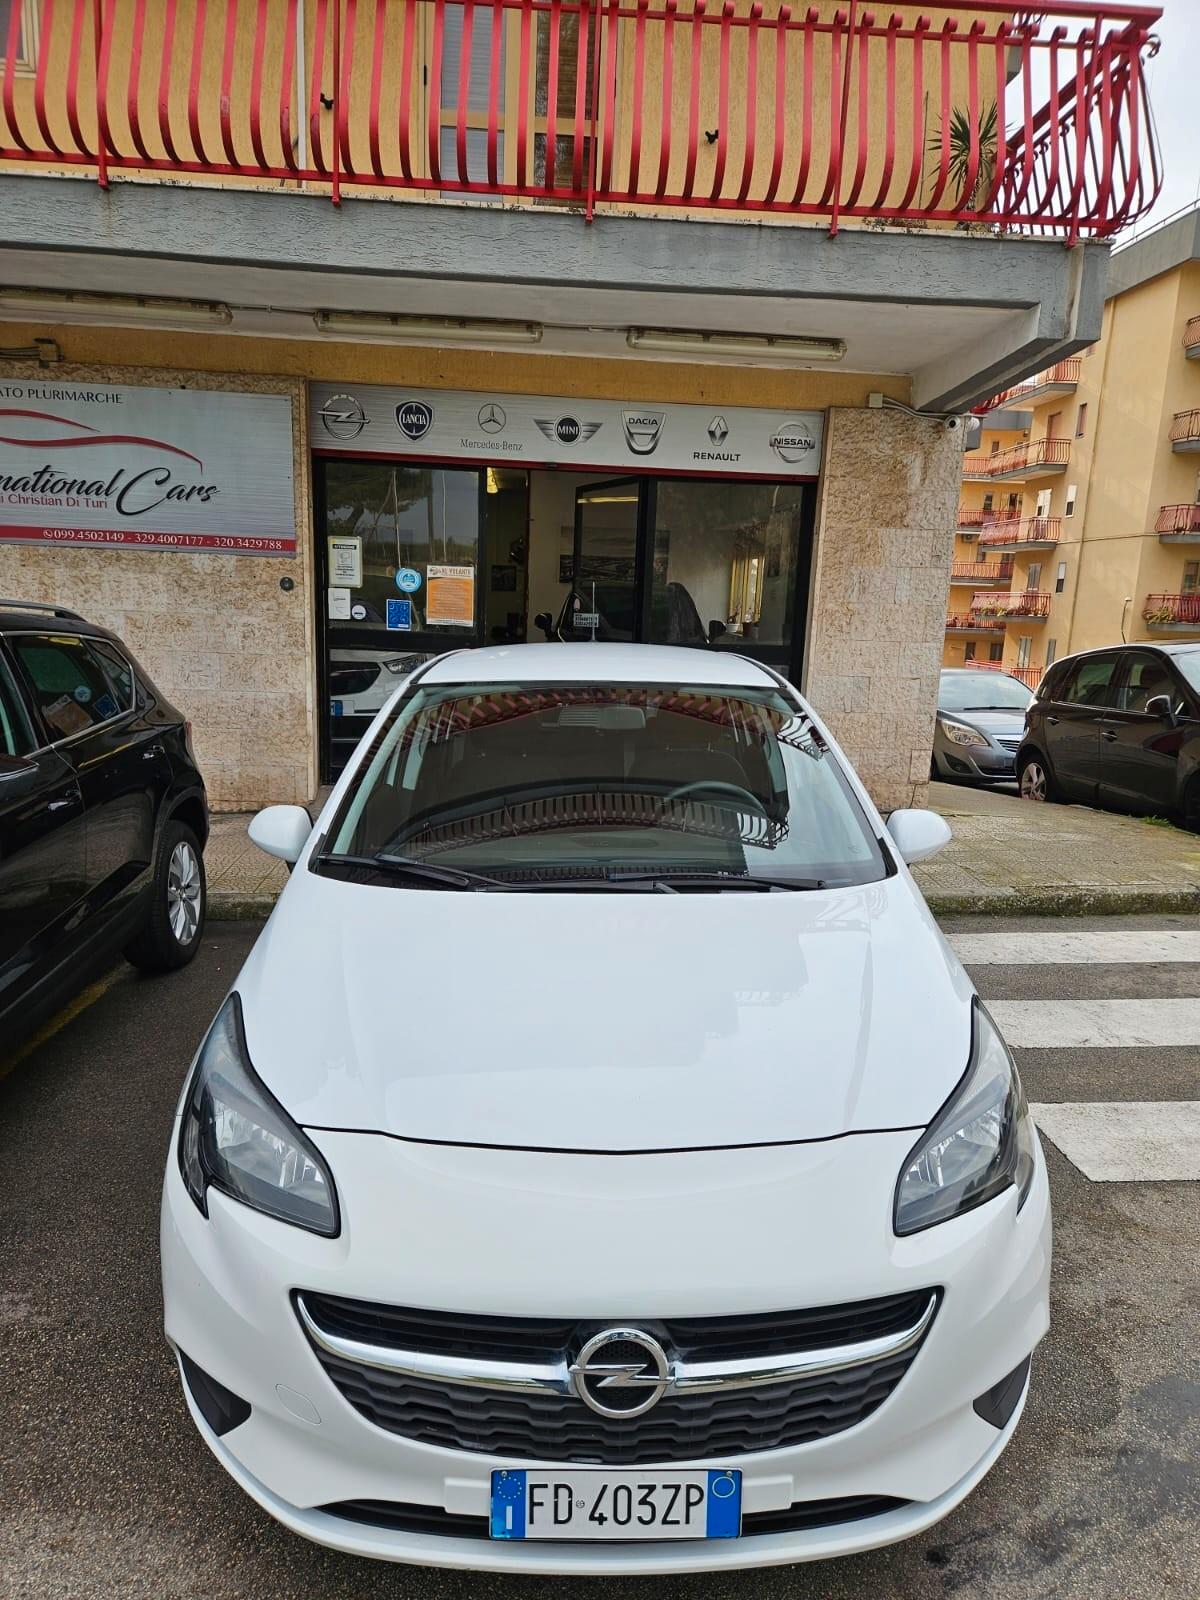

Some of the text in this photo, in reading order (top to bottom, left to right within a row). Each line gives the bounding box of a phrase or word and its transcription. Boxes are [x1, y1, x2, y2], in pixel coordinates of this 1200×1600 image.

[28, 388, 124, 404] PLURIMARCHE
[402, 413, 427, 425] LANCIA
[628, 417, 659, 427] DACIA
[558, 425, 579, 435] MINI
[460, 439, 523, 451] Mercedes-Benz
[774, 437, 812, 448] NISSAN
[693, 452, 741, 462] RENAULT
[116, 467, 221, 516] Cars
[8, 493, 62, 506] Christian
[66, 496, 80, 508] Di
[83, 497, 108, 509] Turi
[53, 529, 125, 543] 099.4502149
[135, 532, 203, 546] 329.4007177
[213, 536, 282, 550] 320.3429788
[528, 1483, 574, 1525] FD
[588, 1484, 705, 1526] 403ZP
